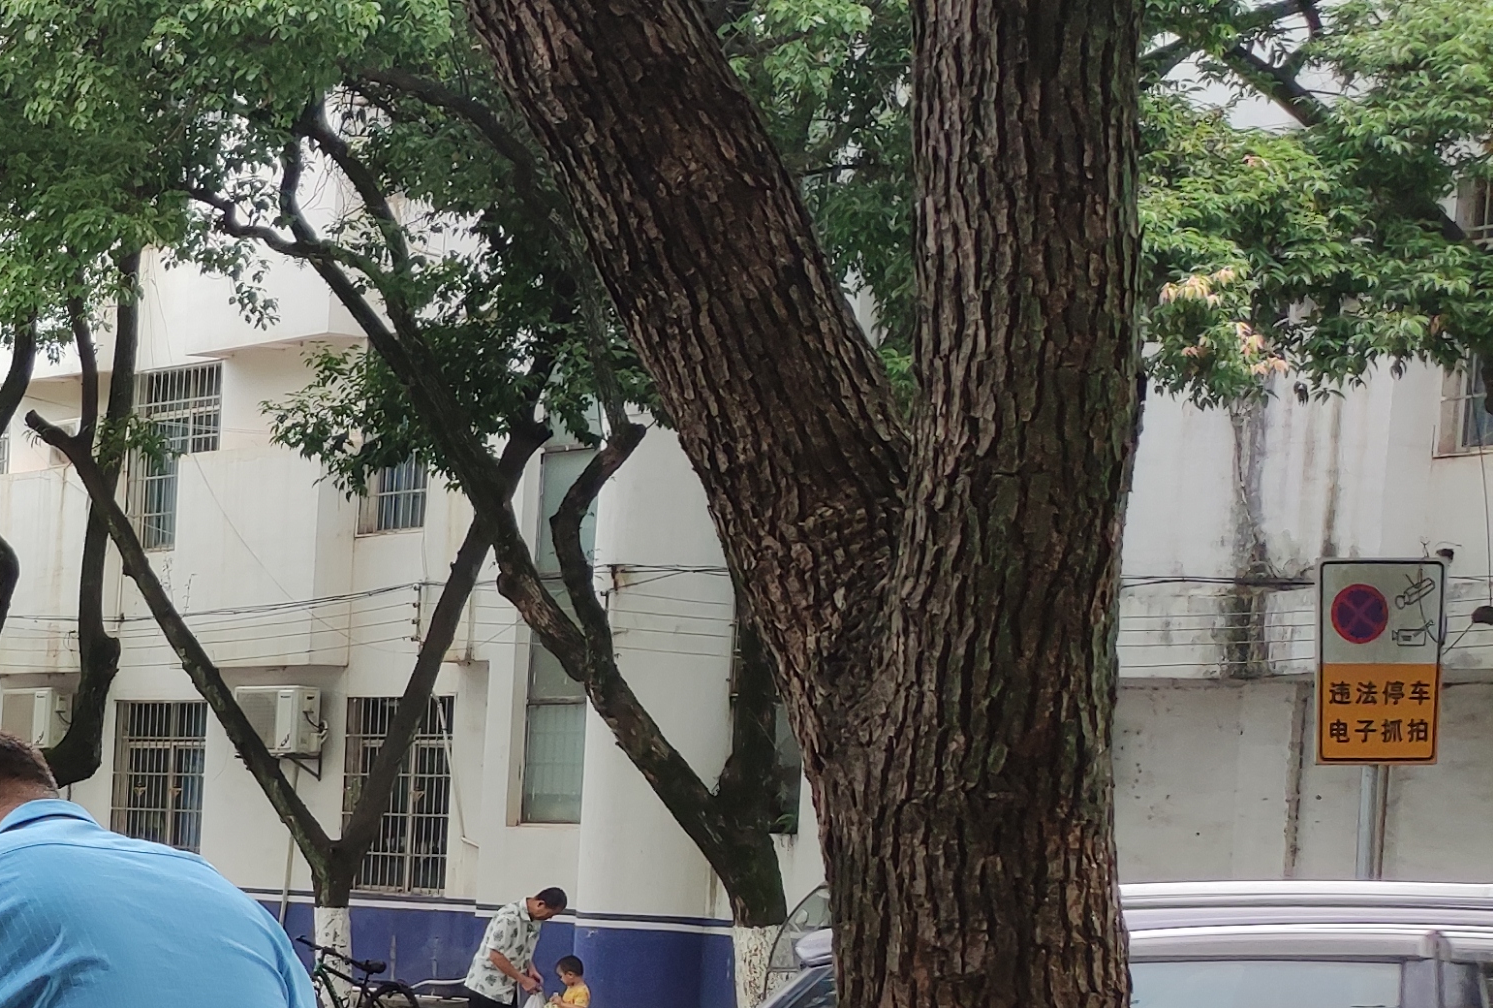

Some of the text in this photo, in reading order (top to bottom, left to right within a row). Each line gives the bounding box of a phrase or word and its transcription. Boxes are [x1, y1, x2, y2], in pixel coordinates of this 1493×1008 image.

[1329, 681, 1431, 705] 违法停车
[1329, 719, 1429, 743] 电子抓拍
